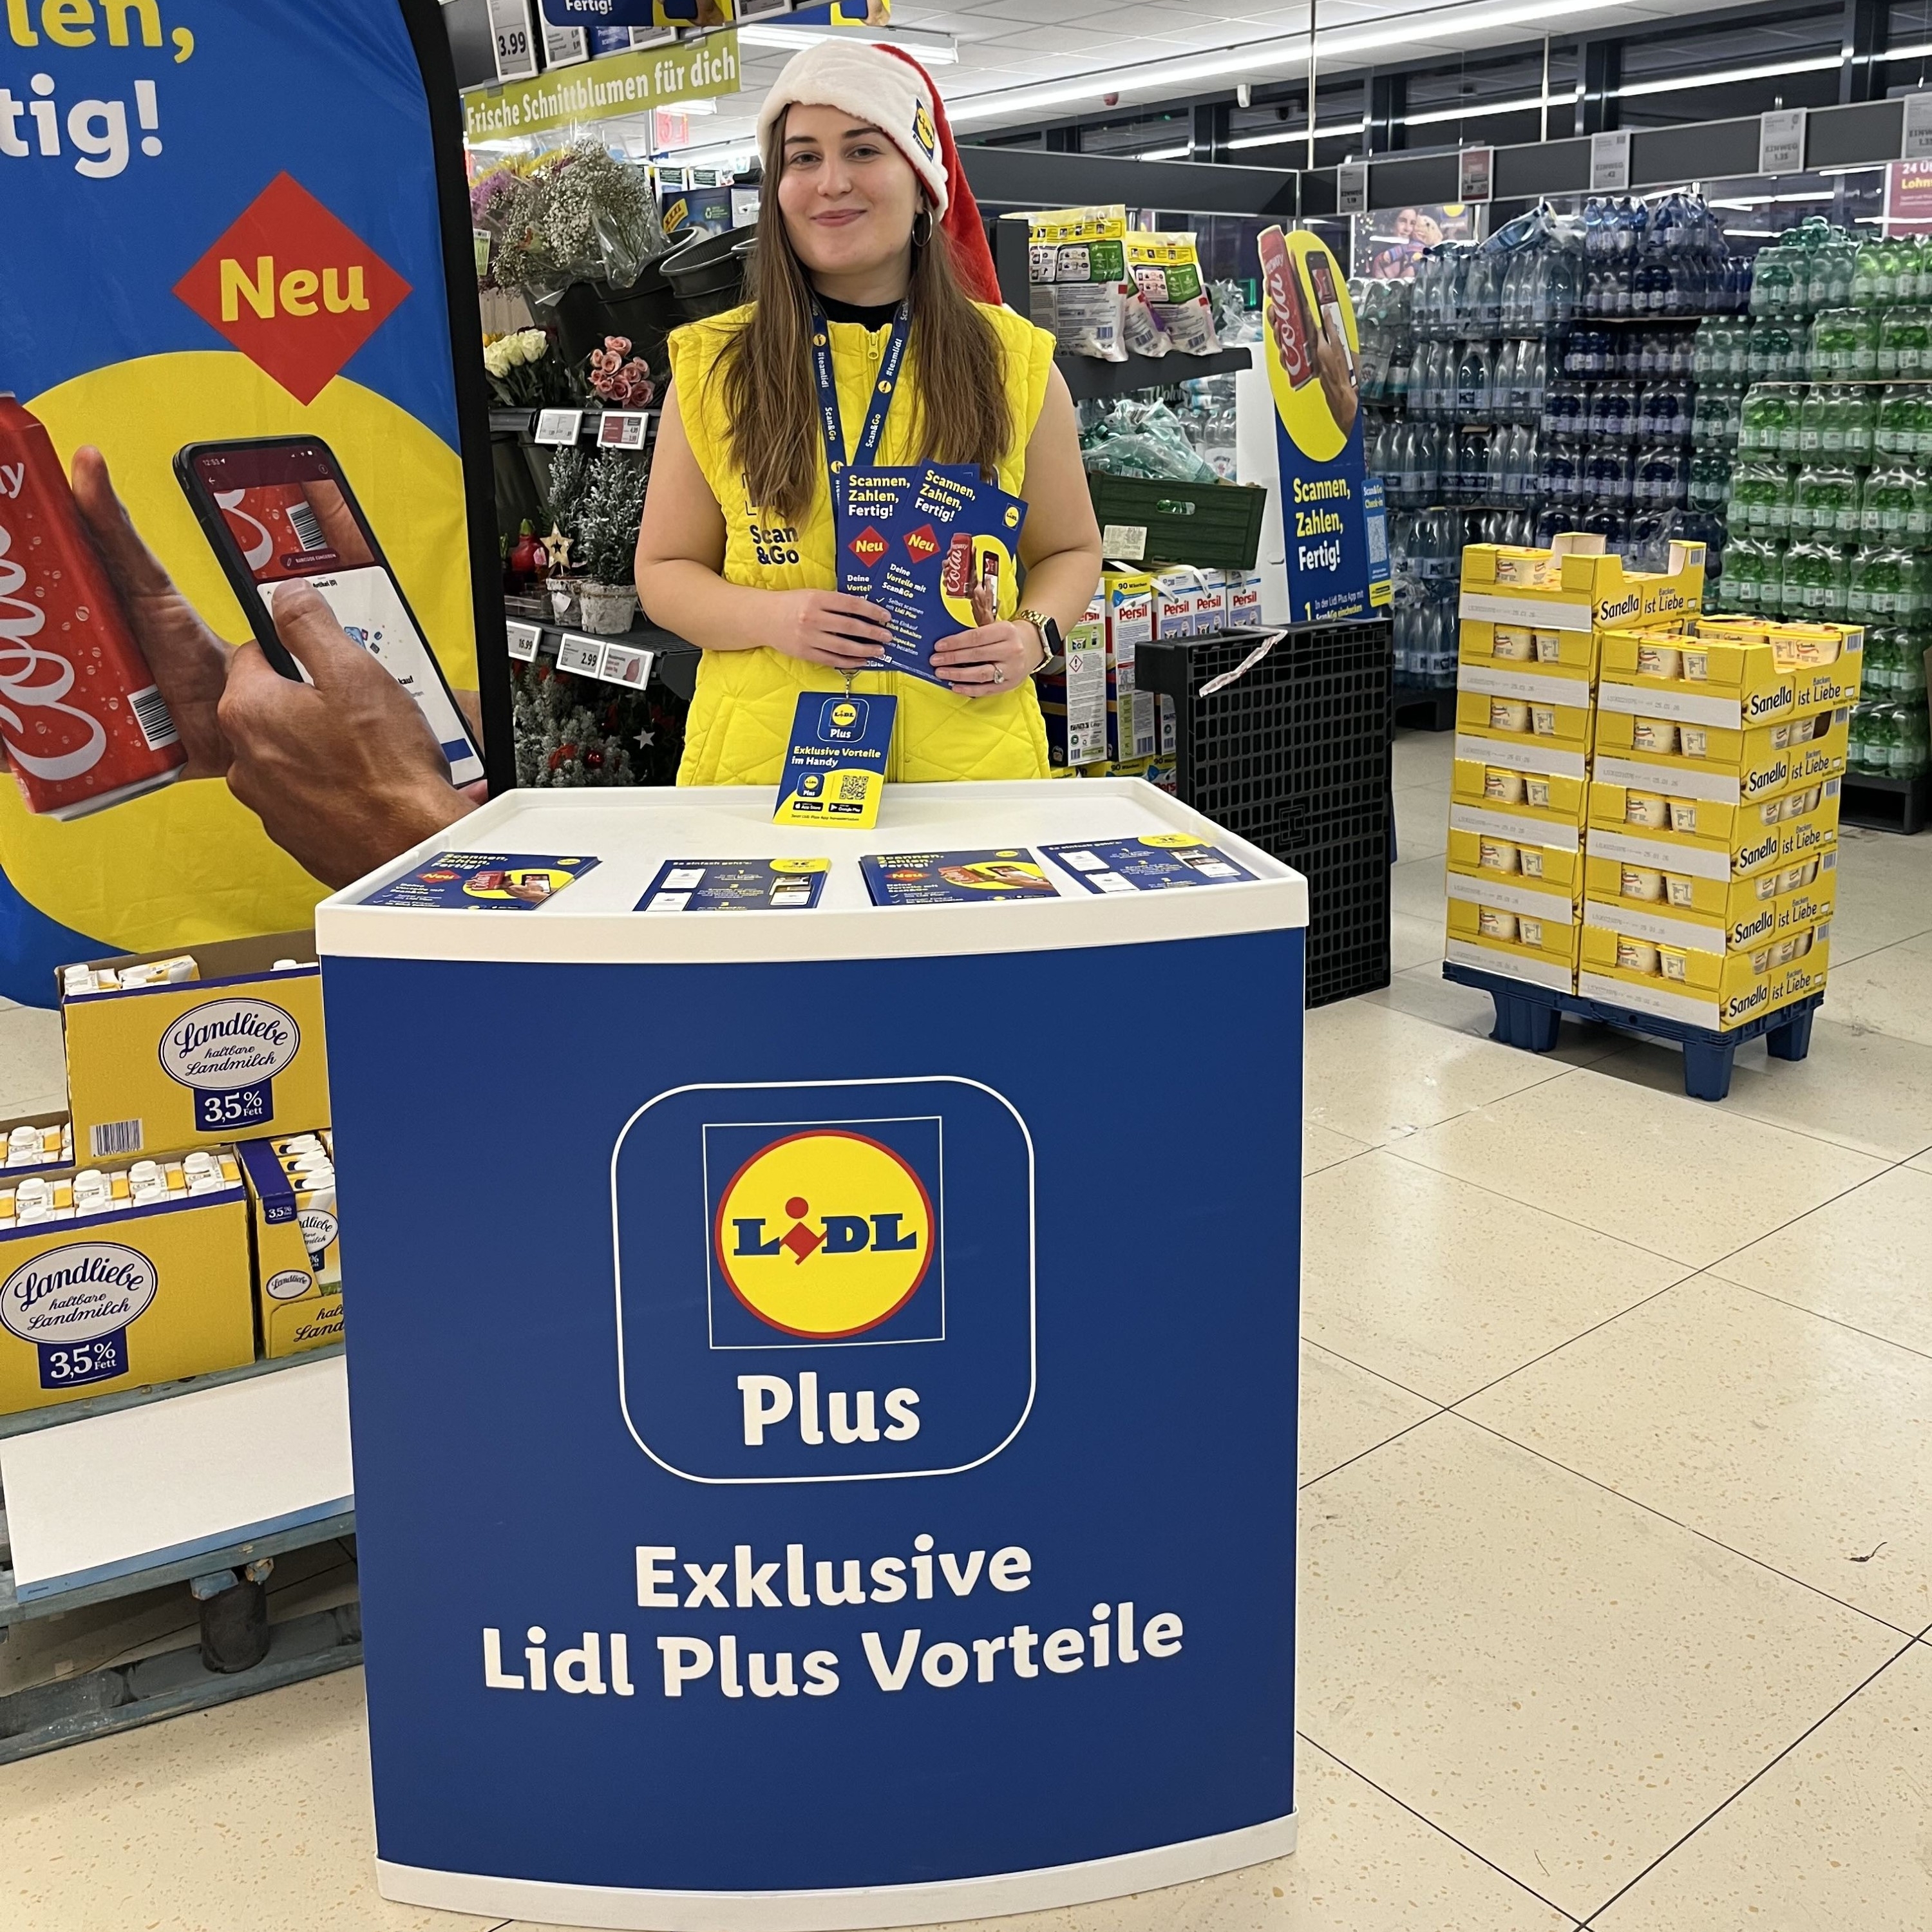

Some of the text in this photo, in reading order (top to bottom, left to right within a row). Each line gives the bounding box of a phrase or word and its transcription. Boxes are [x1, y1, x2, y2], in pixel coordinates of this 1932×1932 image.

[498, 32, 526, 57] 3.99
[467, 48, 735, 134] Frische Schnittblumen für dich
[1902, 162, 1917, 175] 24
[1902, 177, 1932, 189] Lohn
[220, 256, 370, 322] Neu
[885, 339, 903, 377] #teamlidl
[817, 351, 829, 388] #teamlidl
[824, 406, 837, 442] Scan&Go
[865, 413, 881, 449] Scan&Go
[848, 475, 911, 489] Scannen,
[925, 469, 976, 502] Scannen,
[1293, 477, 1350, 504] Scannen,
[848, 489, 900, 504] Zahlen,
[919, 483, 962, 512] Zahlen,
[848, 504, 894, 520] Fertig!
[914, 497, 956, 523] Fertig!
[1295, 508, 1343, 537] Zahlen,
[749, 524, 799, 545] Scan
[907, 534, 935, 553] Neu
[756, 545, 799, 565] &Go
[855, 540, 884, 553] Neu
[1298, 539, 1341, 572] Fertig!
[889, 563, 911, 577] Deine
[881, 582, 914, 599] Scan&Go
[886, 572, 927, 593] Vorteile mit
[1164, 600, 1189, 616] Persil
[1197, 595, 1222, 610] Persil
[1233, 589, 1257, 606] Persil
[1600, 594, 1640, 621] Sanella
[1644, 597, 1656, 614] ist
[1658, 594, 1684, 611] Liebe
[1078, 613, 1100, 622] ersil
[1119, 604, 1147, 621] Persil
[581, 652, 597, 667] 2.99
[1750, 683, 1841, 715] Sanella ist Liebe
[829, 728, 851, 739] Plus
[791, 755, 839, 768] im Handy
[793, 746, 881, 759] Exklusive Vorteile
[1748, 755, 1829, 792] Sanella ist Liebe
[442, 853, 509, 862] Scannen,
[1739, 829, 1821, 869] Sanella ist Liebe
[1734, 903, 1817, 943] Sanella ist Liebe
[1729, 974, 1811, 1018] Sanella ist Liebe
[174, 1012, 289, 1059] Landliebe
[204, 1045, 255, 1059] haltbare
[185, 1051, 276, 1076] Landmilch
[243, 1107, 263, 1116] Fett
[14, 1257, 144, 1312] Landliebe
[270, 1274, 308, 1290] Landliebe
[48, 1293, 106, 1311] haltbare
[27, 1297, 131, 1331] Landmilch
[94, 1360, 117, 1370] Fett
[737, 1372, 921, 1446] Plus
[636, 1533, 1032, 1608] Exklusive
[482, 1602, 1184, 1698] Lidl Plus Vorteile
